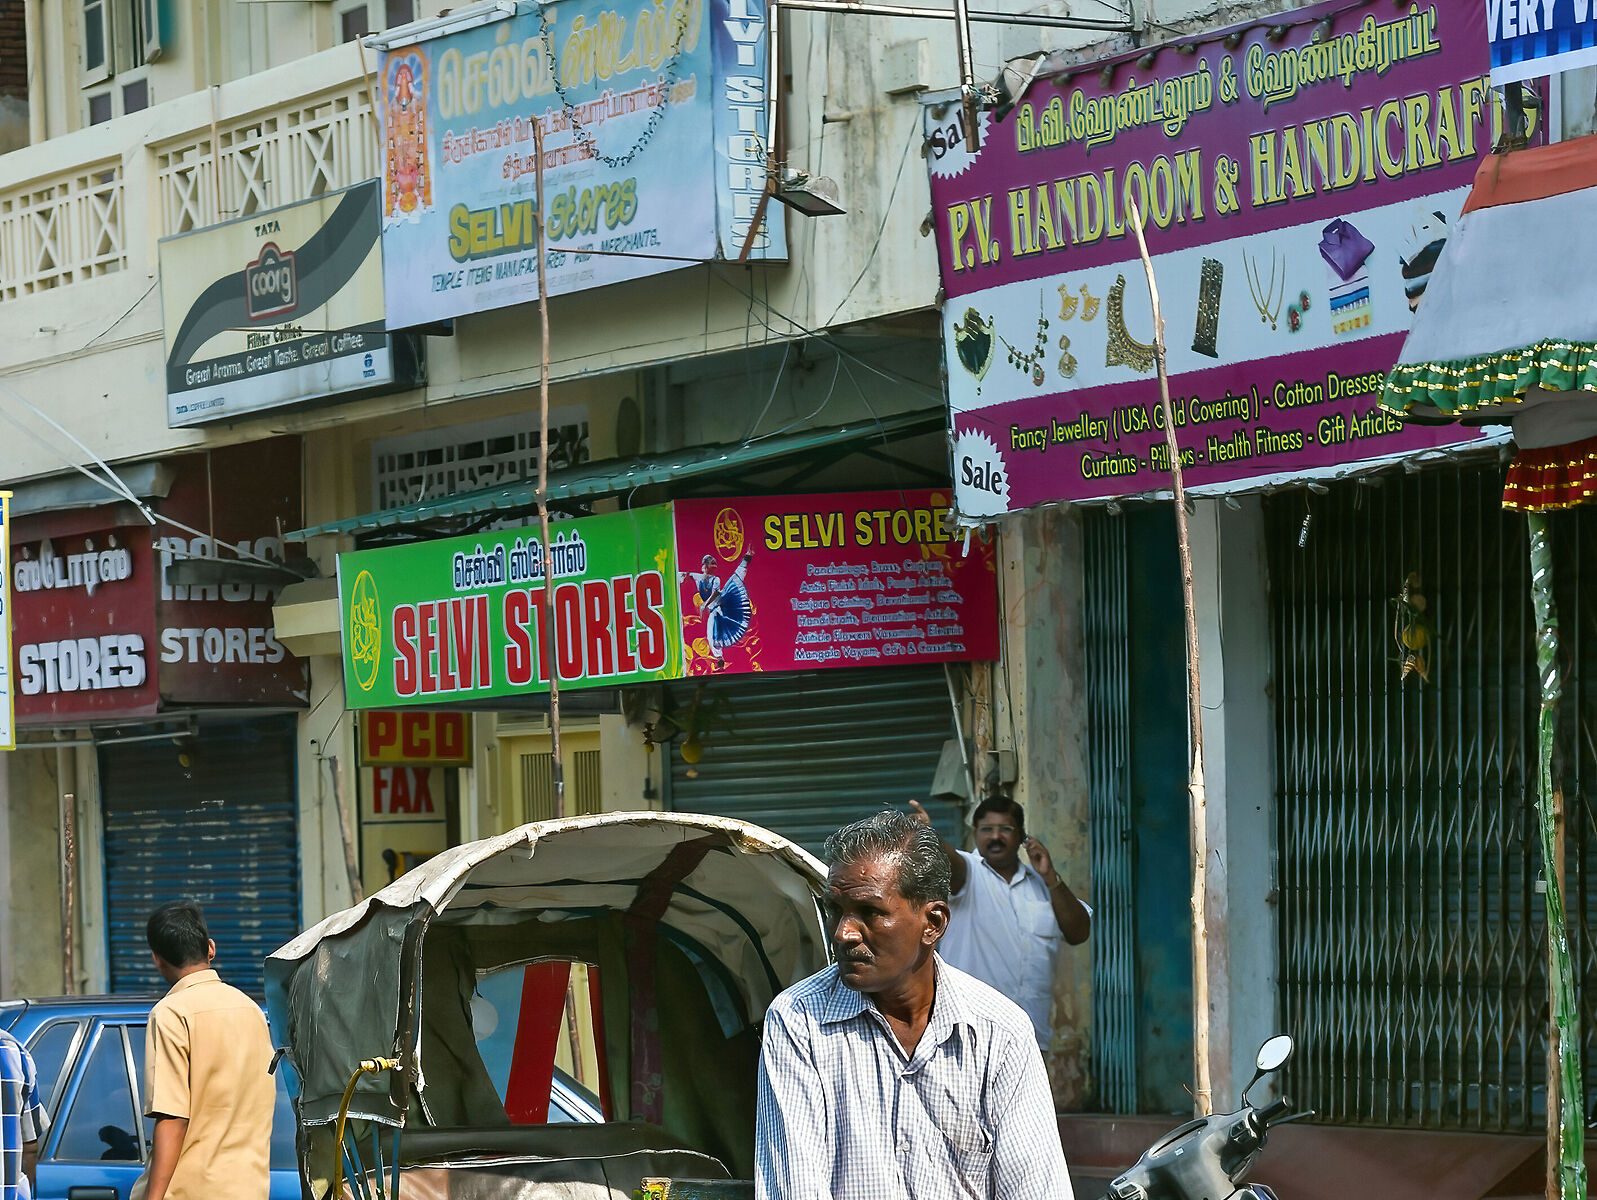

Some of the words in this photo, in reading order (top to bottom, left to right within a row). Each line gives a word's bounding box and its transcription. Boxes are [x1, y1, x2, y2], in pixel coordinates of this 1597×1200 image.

[1219, 54, 1238, 103] &
[1008, 146, 1204, 257] HANDLOOM
[1213, 155, 1241, 215] &
[255, 220, 281, 237] TATA
[449, 199, 537, 263] SELVI
[1010, 424, 1048, 451] Fancy
[1051, 411, 1109, 443] Jewellery
[1153, 399, 1186, 430] Gld
[1189, 392, 1250, 424] Covering
[1274, 382, 1323, 408] Cotton
[1328, 372, 1385, 399] Dresses
[1081, 450, 1137, 479] Curtains
[1207, 431, 1252, 462] Health
[1255, 428, 1303, 454] Fitness
[1318, 415, 1346, 445] Gift
[1350, 410, 1403, 440] Articles
[961, 455, 1003, 496] Sale
[764, 511, 846, 551] SELVI
[160, 627, 285, 664] STORES
[392, 594, 492, 697] SELVI
[504, 569, 668, 686] STORES
[19, 634, 147, 695] STORES
[368, 711, 464, 758] PCO
[373, 766, 435, 814] FAX
